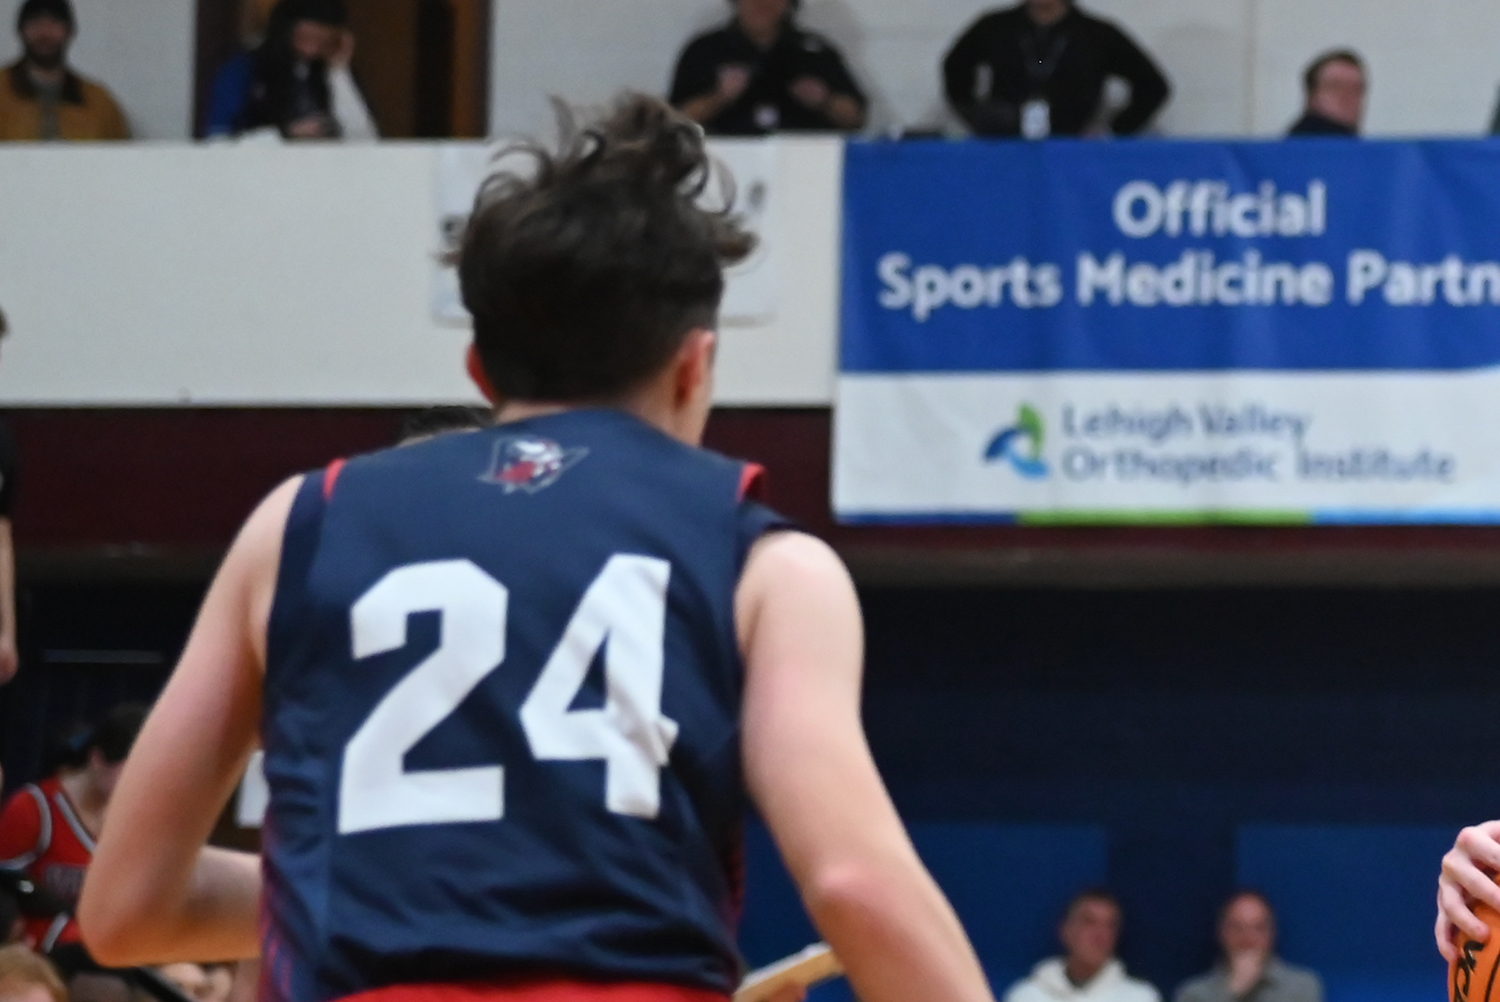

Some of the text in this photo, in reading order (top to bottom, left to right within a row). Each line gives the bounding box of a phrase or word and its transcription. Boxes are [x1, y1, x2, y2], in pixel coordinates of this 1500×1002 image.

[1114, 179, 1326, 237] Official
[877, 252, 1061, 322] Sports
[1077, 249, 1333, 306] Medicine
[1061, 403, 1311, 445] Lehigh Valley
[1061, 444, 1455, 486] Orthopedic Institute
[338, 552, 678, 834] 24
